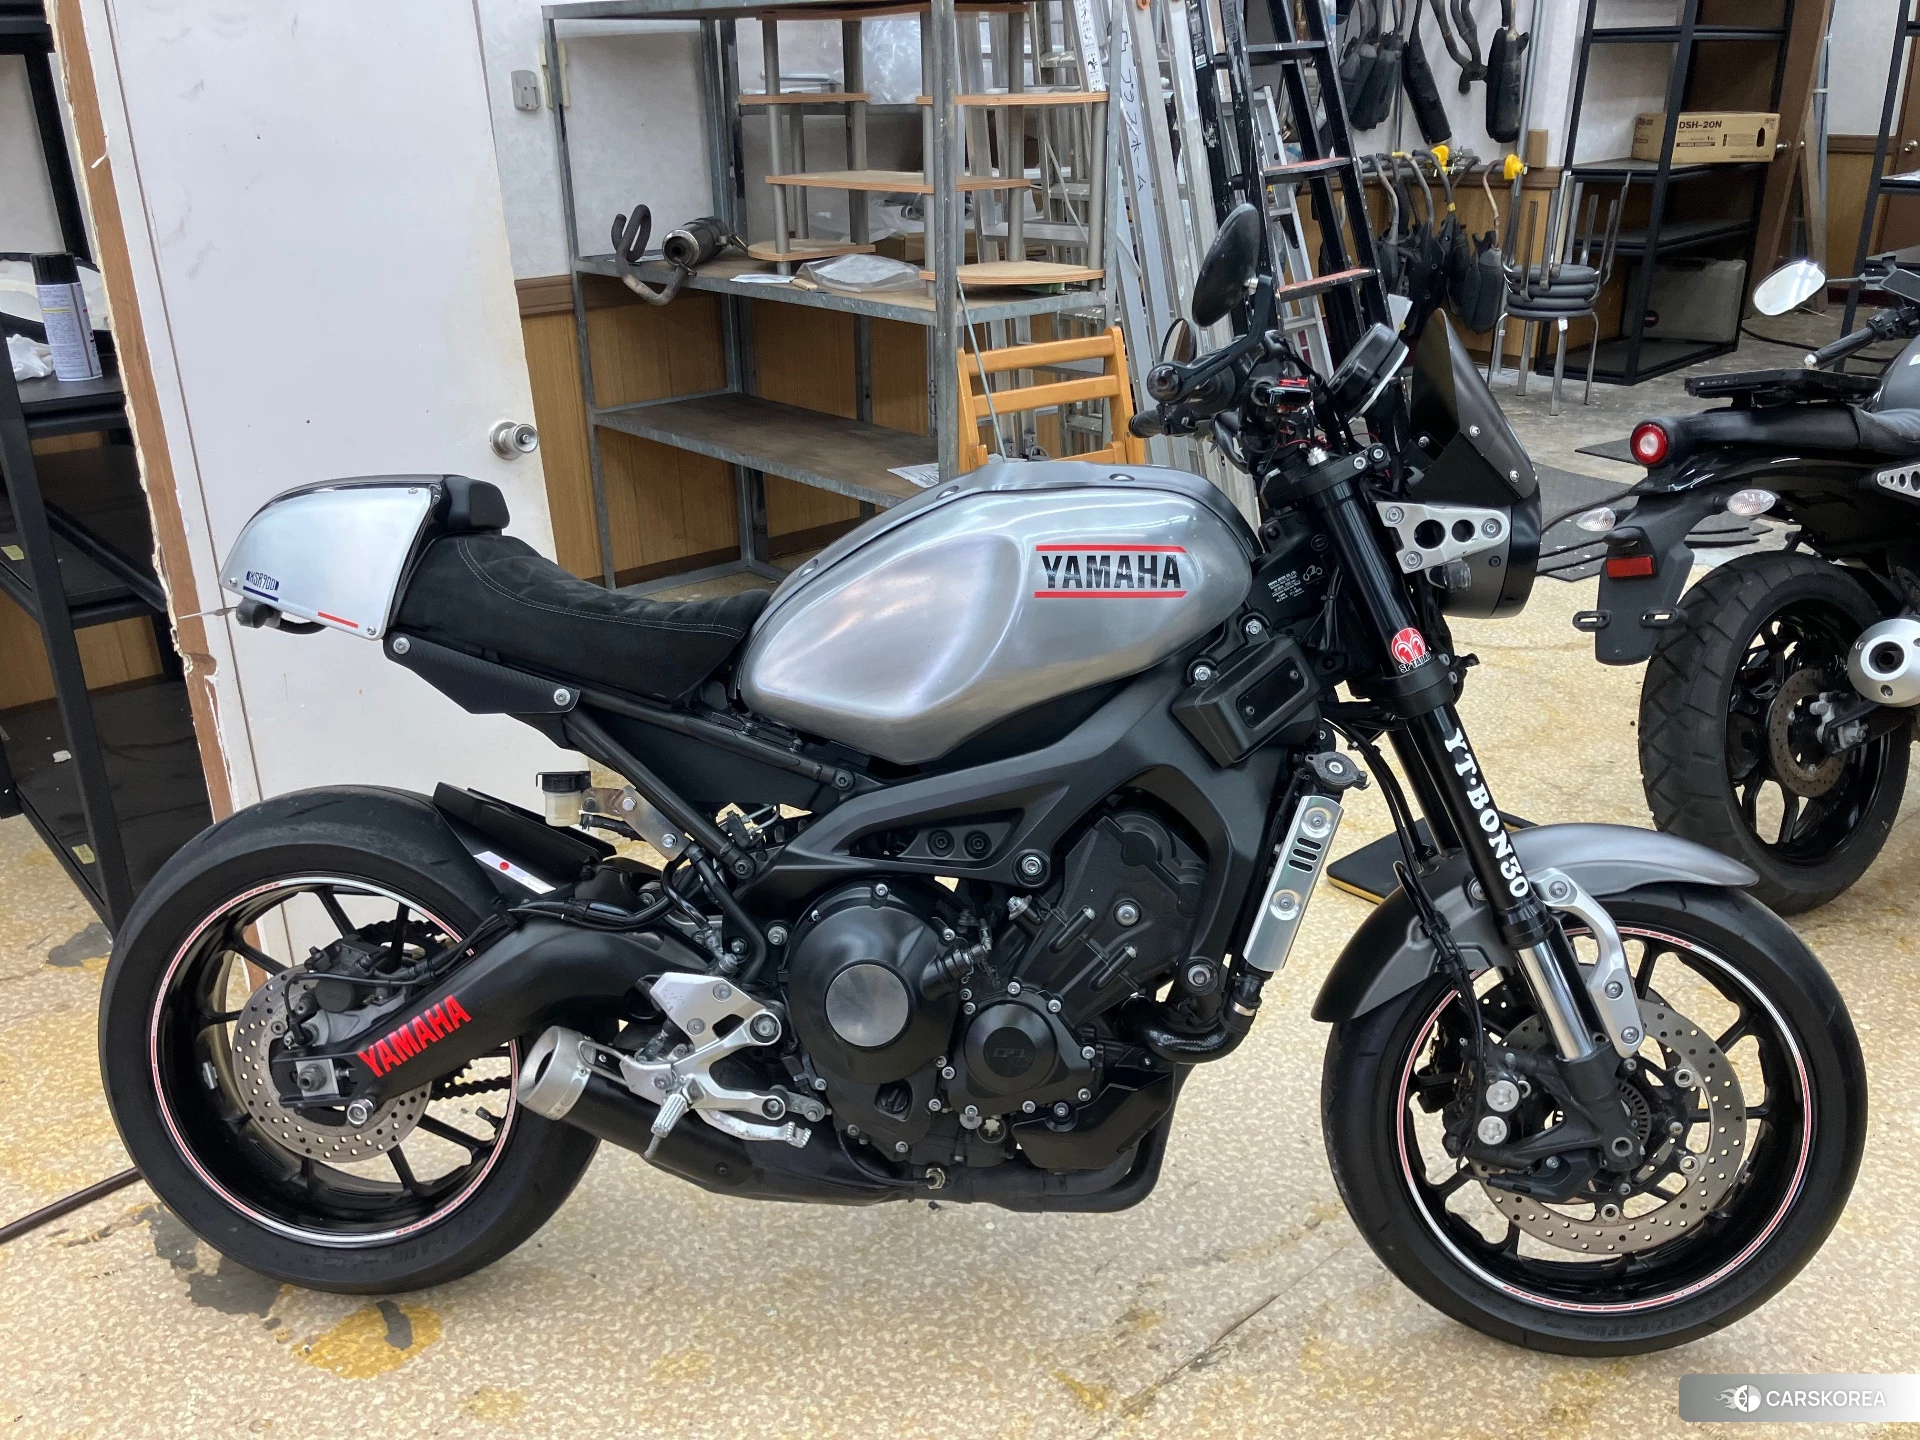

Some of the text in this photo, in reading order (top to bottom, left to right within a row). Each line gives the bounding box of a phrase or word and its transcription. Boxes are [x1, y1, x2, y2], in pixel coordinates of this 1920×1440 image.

[1679, 120, 1722, 129] DSH-20N
[1041, 554, 1181, 588] YAMAHA
[357, 994, 472, 1078] YAMAHA
